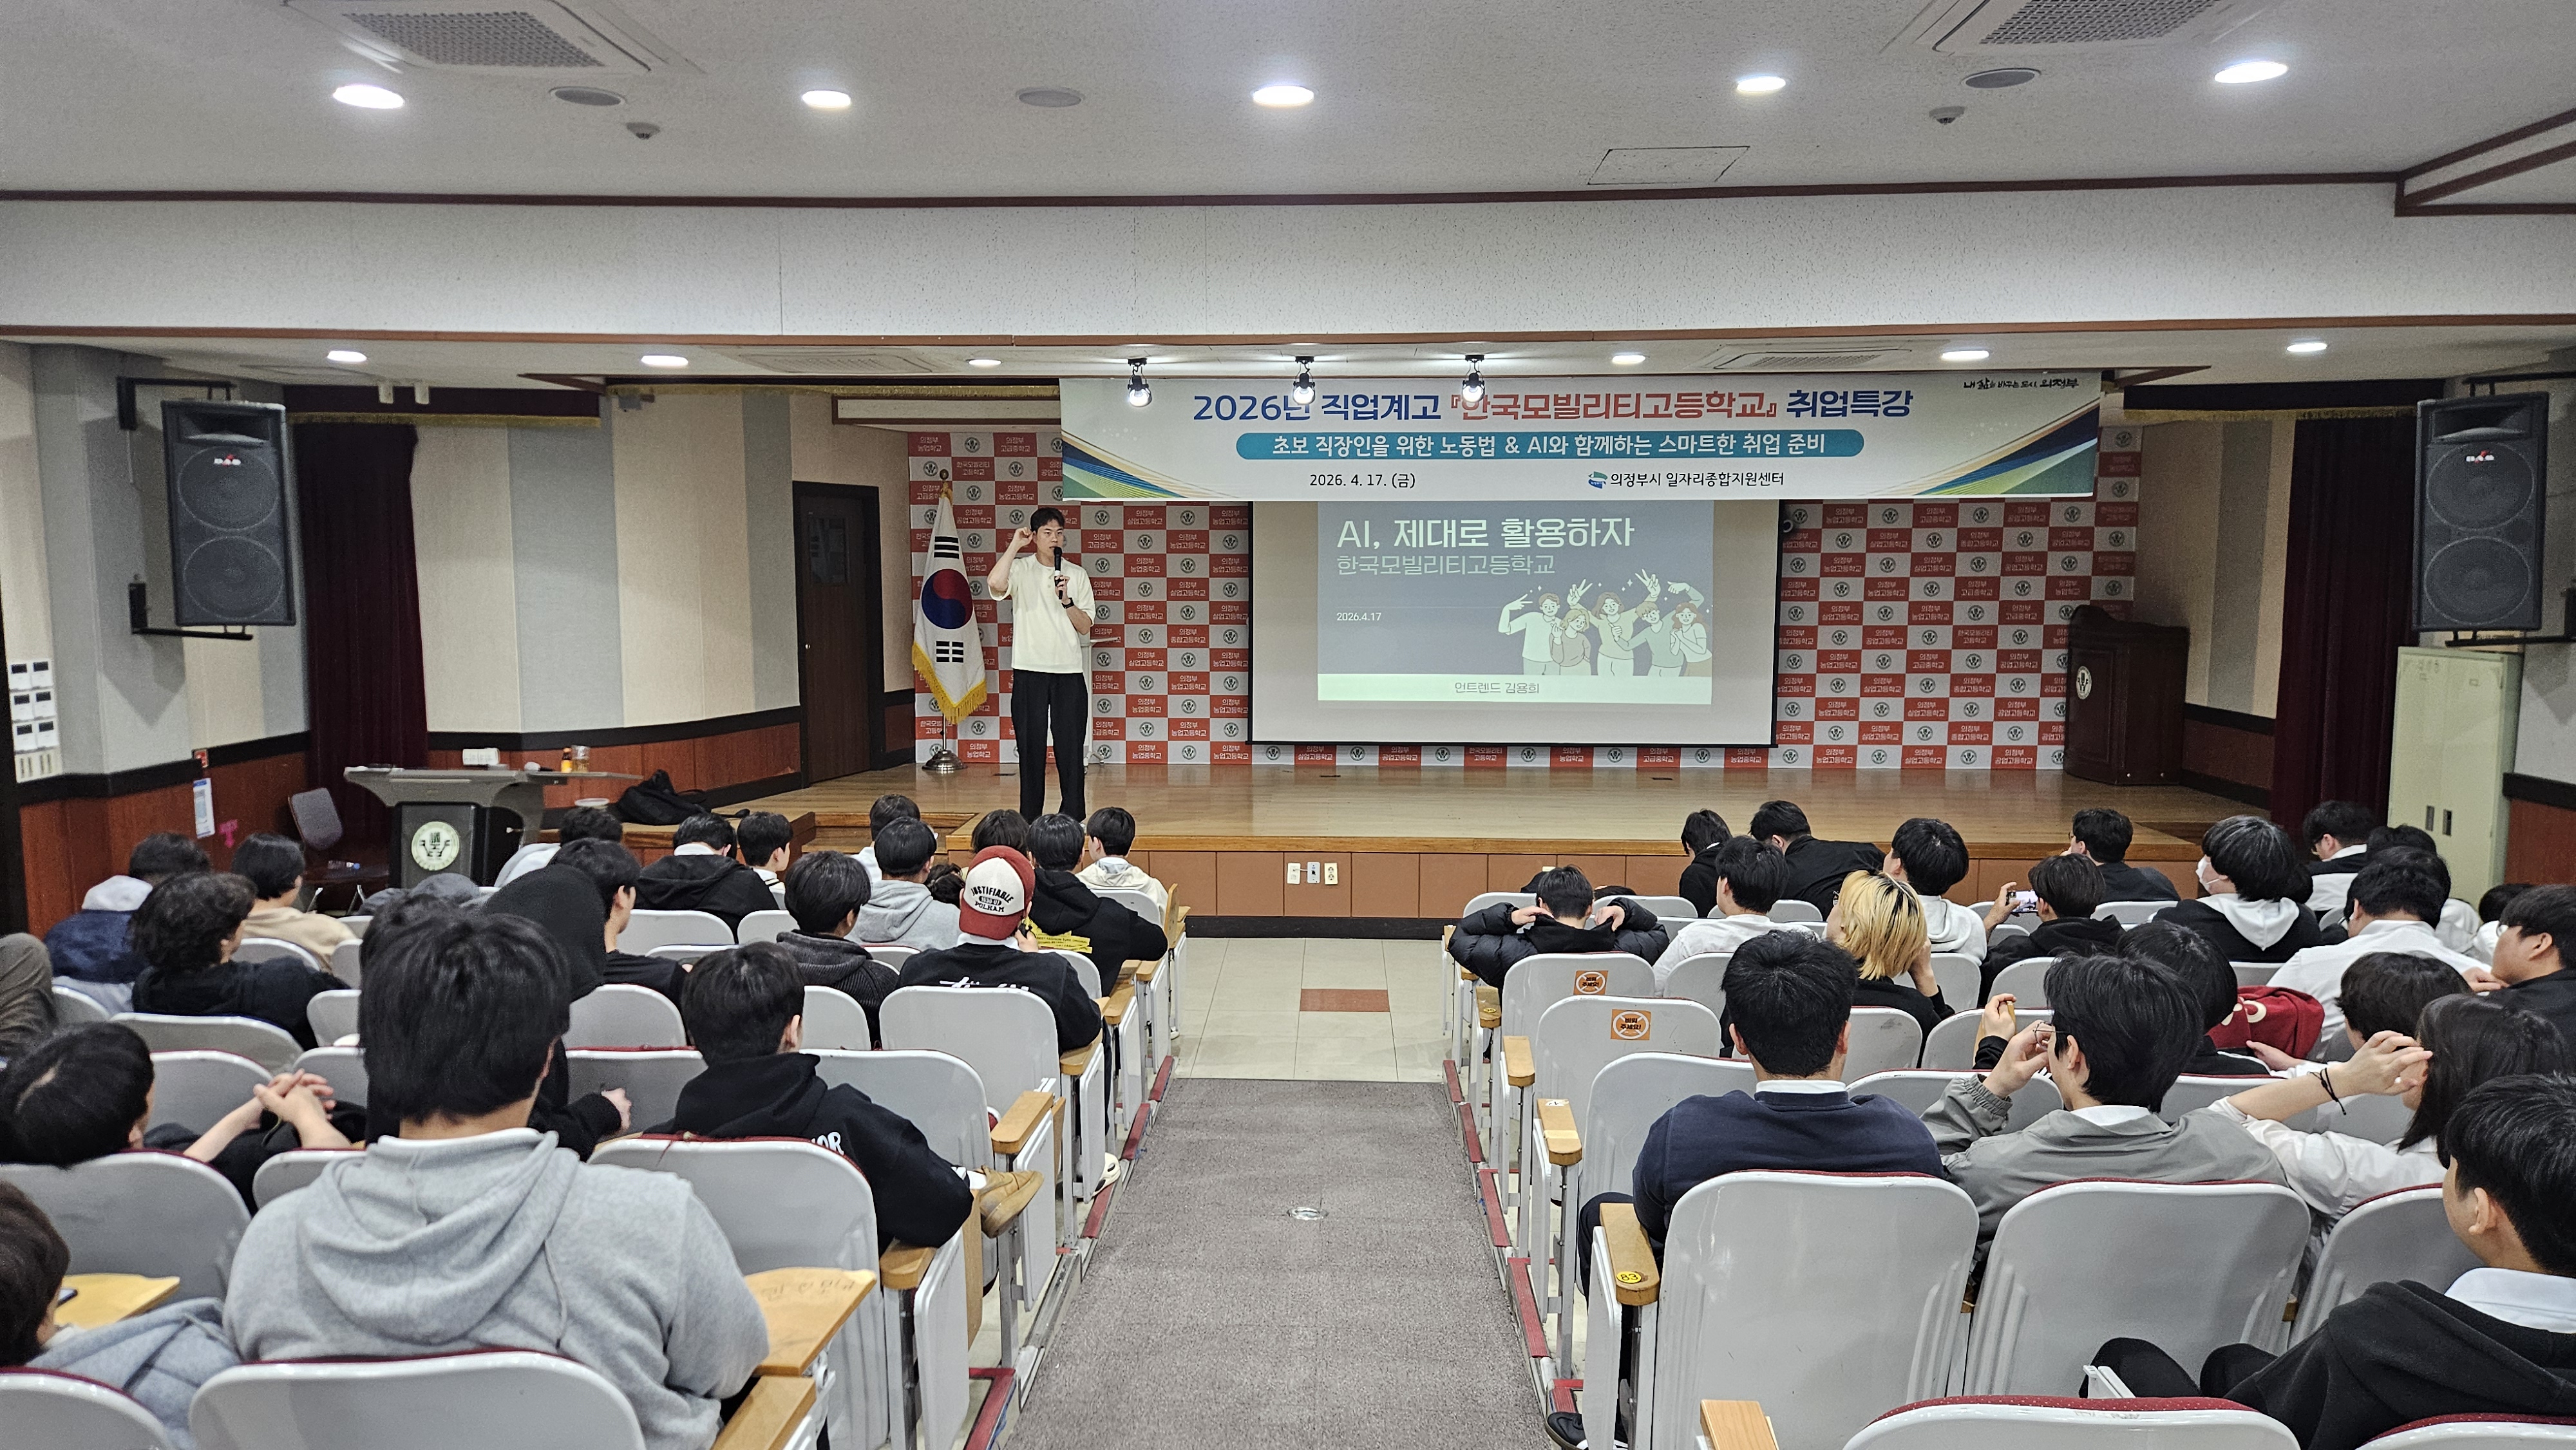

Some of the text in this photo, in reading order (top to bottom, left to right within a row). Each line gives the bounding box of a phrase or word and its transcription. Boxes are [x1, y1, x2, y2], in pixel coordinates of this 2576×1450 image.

[2040, 378, 2079, 388] 의정부
[1194, 395, 1310, 420] 2026년
[1321, 394, 1441, 420] 직업계고
[1786, 390, 1913, 418] 취업특강
[1273, 433, 1825, 457] 초보 직장인을 위한 노동법 & AI와 함께하는 스마트한 취업 준비
[1310, 473, 1416, 488] 2026. 4. 17. (금)
[1611, 472, 1784, 487] 의정부시 일자리종합지원센터
[1337, 518, 1634, 549] AI, 제대로 활용하자
[1337, 554, 1555, 575] 한국모빌리티고등학교
[1336, 612, 1381, 621] 2026.4.17
[1455, 682, 1539, 693] 언트렌드 김용희
[971, 885, 1014, 903] JUSTIFIABLE
[974, 901, 1005, 912] POLHAM
